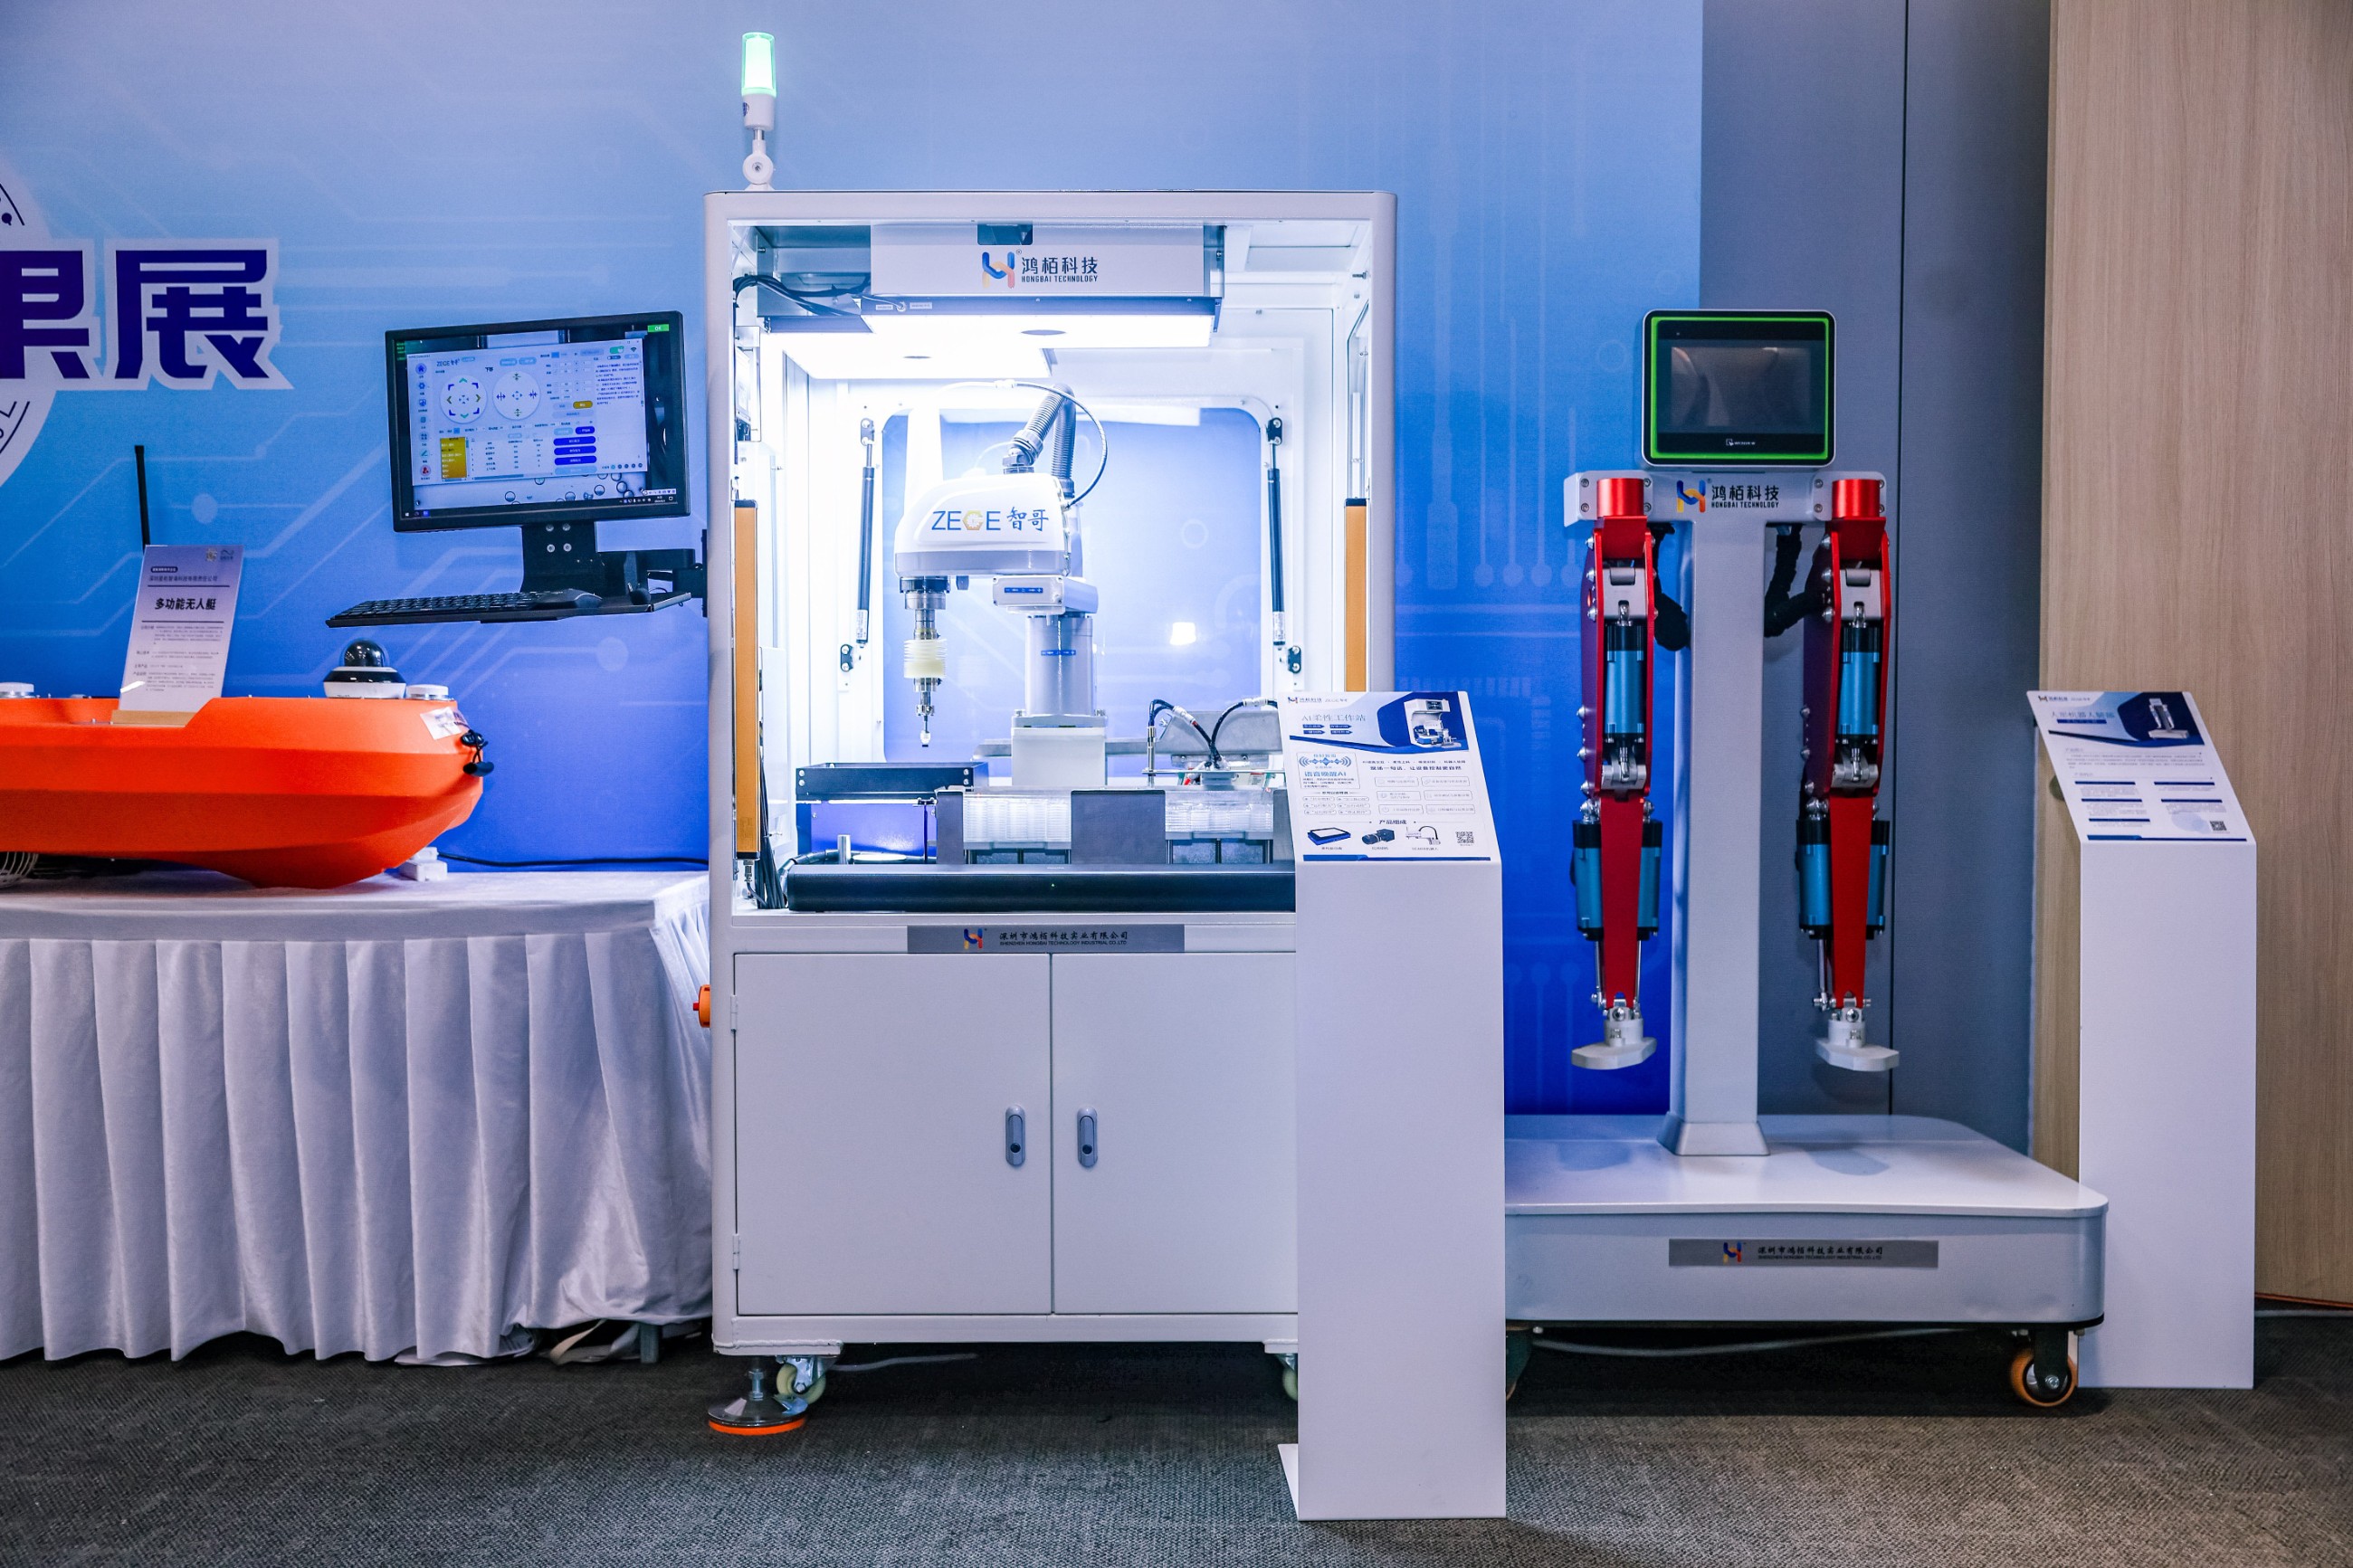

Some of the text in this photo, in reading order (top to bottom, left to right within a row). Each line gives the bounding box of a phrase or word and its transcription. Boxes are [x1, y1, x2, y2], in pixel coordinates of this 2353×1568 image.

[1021, 275, 1099, 283] HONGBAI TECHNOLOGY
[931, 507, 1049, 531] ZEGE 智哥
[154, 597, 216, 610] 多功能无人艇
